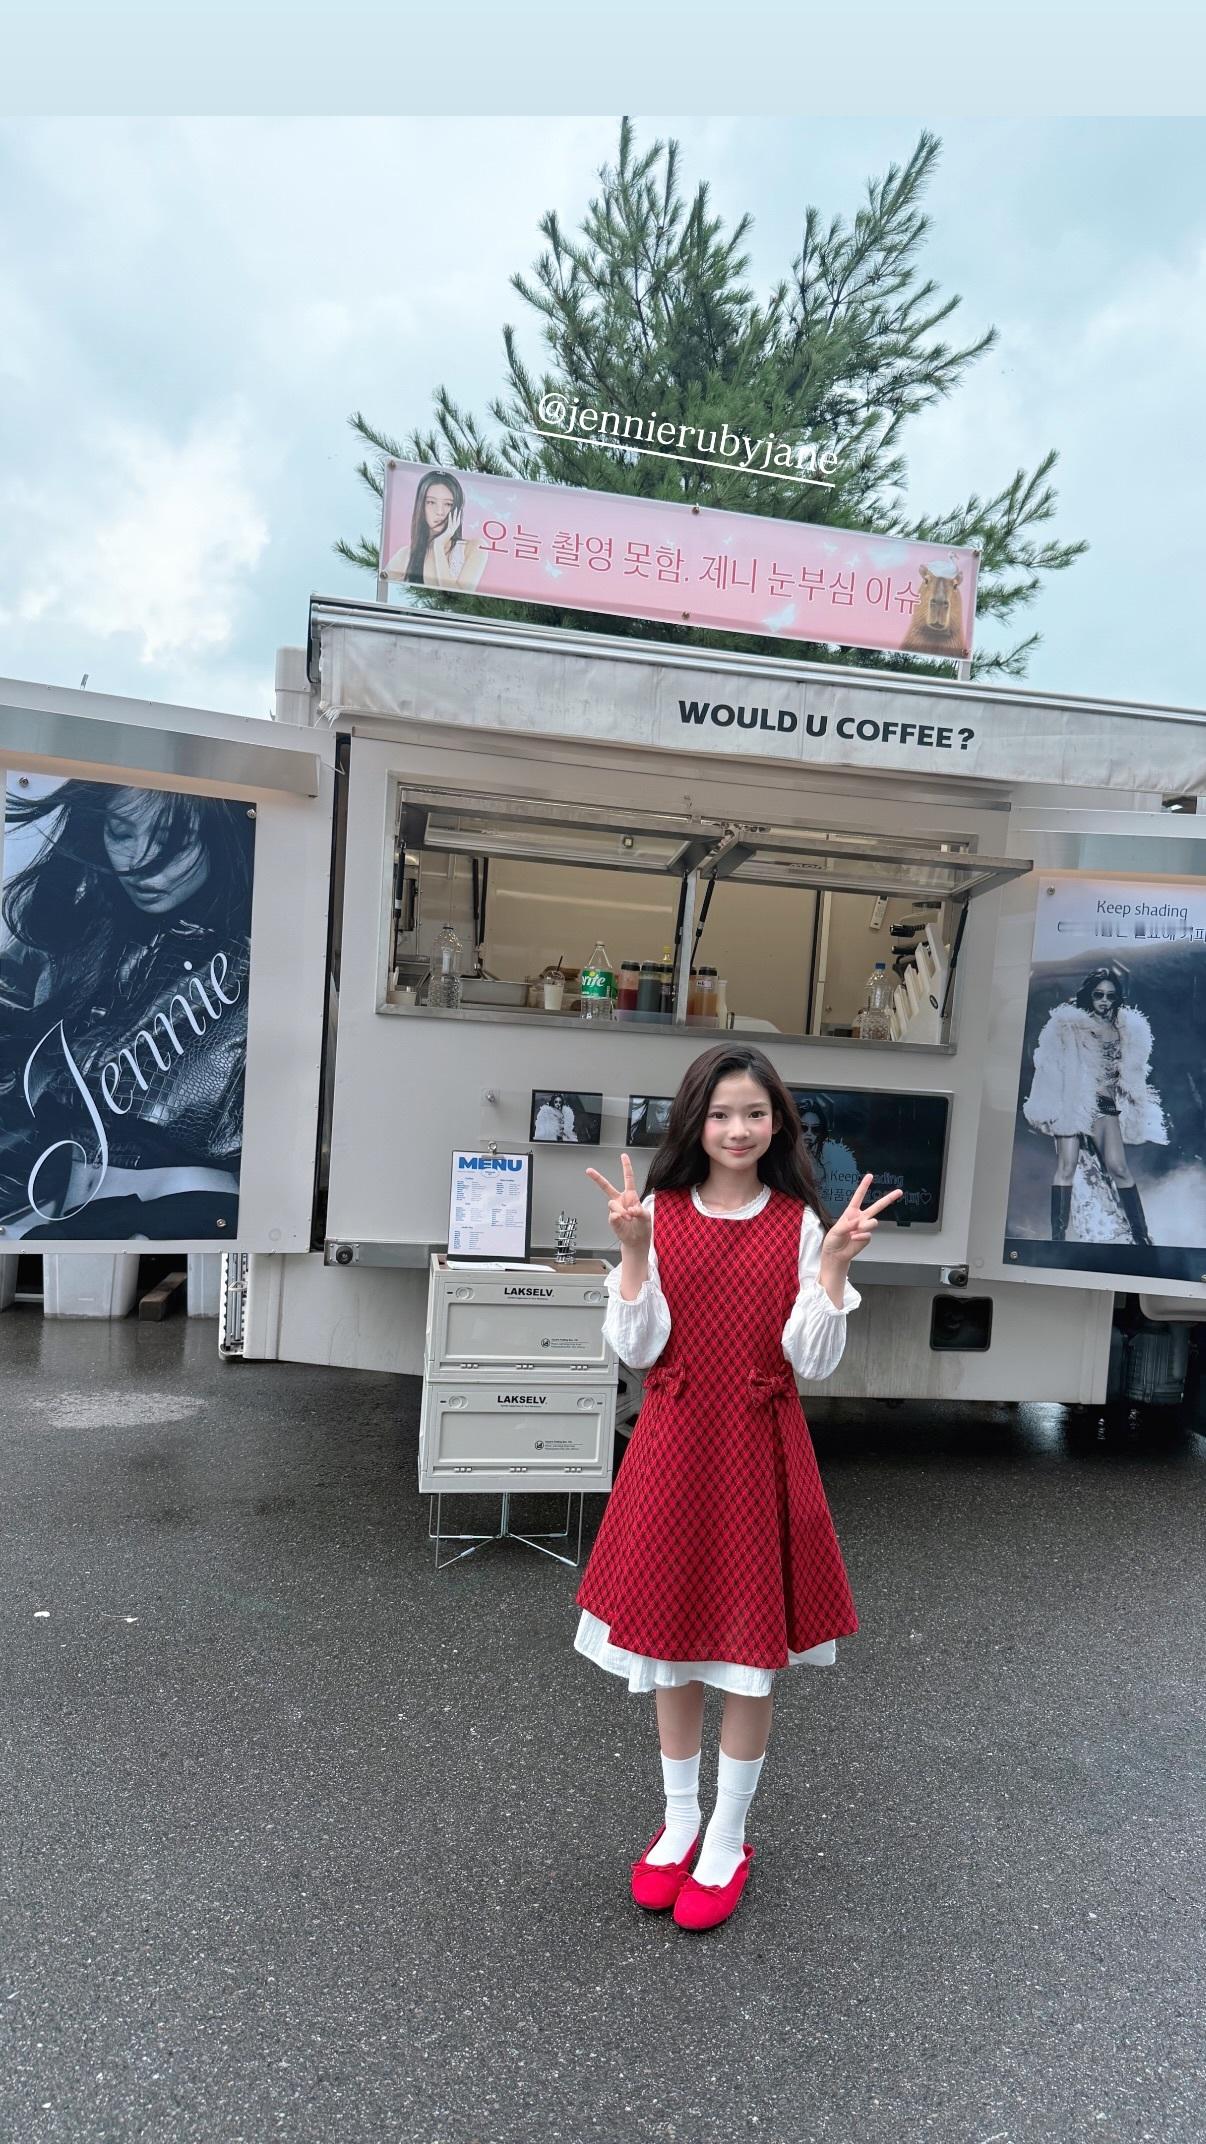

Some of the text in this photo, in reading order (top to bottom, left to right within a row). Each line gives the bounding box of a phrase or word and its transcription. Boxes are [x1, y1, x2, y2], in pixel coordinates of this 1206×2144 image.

[478, 520, 922, 615] 오늘 촬영 못함. 제니 눈부심 이슈
[678, 700, 798, 733] WOULD
[806, 714, 828, 737] U
[1096, 900, 1188, 920] Keep shading
[23, 951, 242, 1222] Jennie
[458, 1156, 523, 1172] MENU
[830, 1169, 857, 1184] Keep
[504, 1287, 553, 1297] LAKSELV
[497, 1395, 547, 1404] LAKSELV
